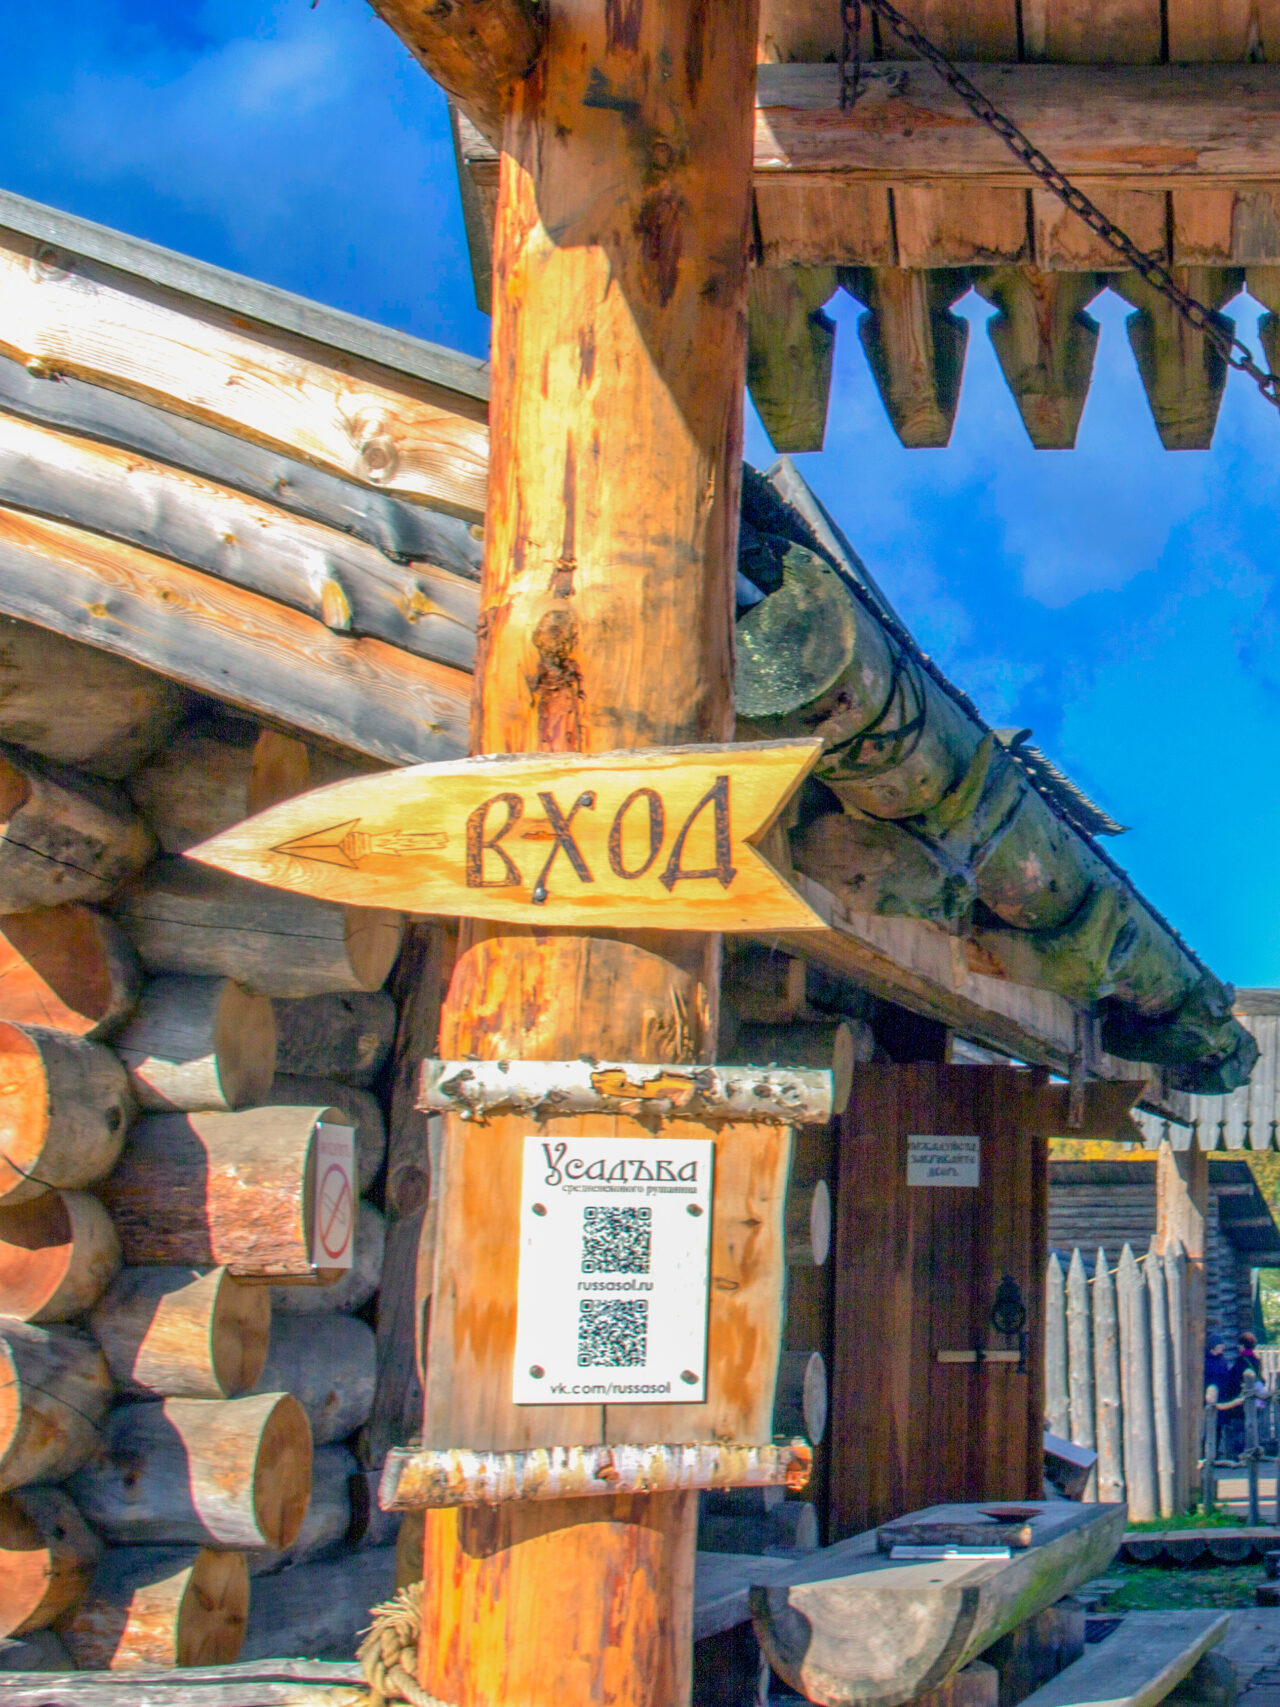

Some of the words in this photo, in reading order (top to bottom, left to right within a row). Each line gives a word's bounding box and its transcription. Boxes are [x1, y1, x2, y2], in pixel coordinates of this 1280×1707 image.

[465, 775, 738, 905] ВХОД
[577, 1279, 654, 1292] russasol.ru
[550, 1381, 671, 1396] vk.com/russasol
